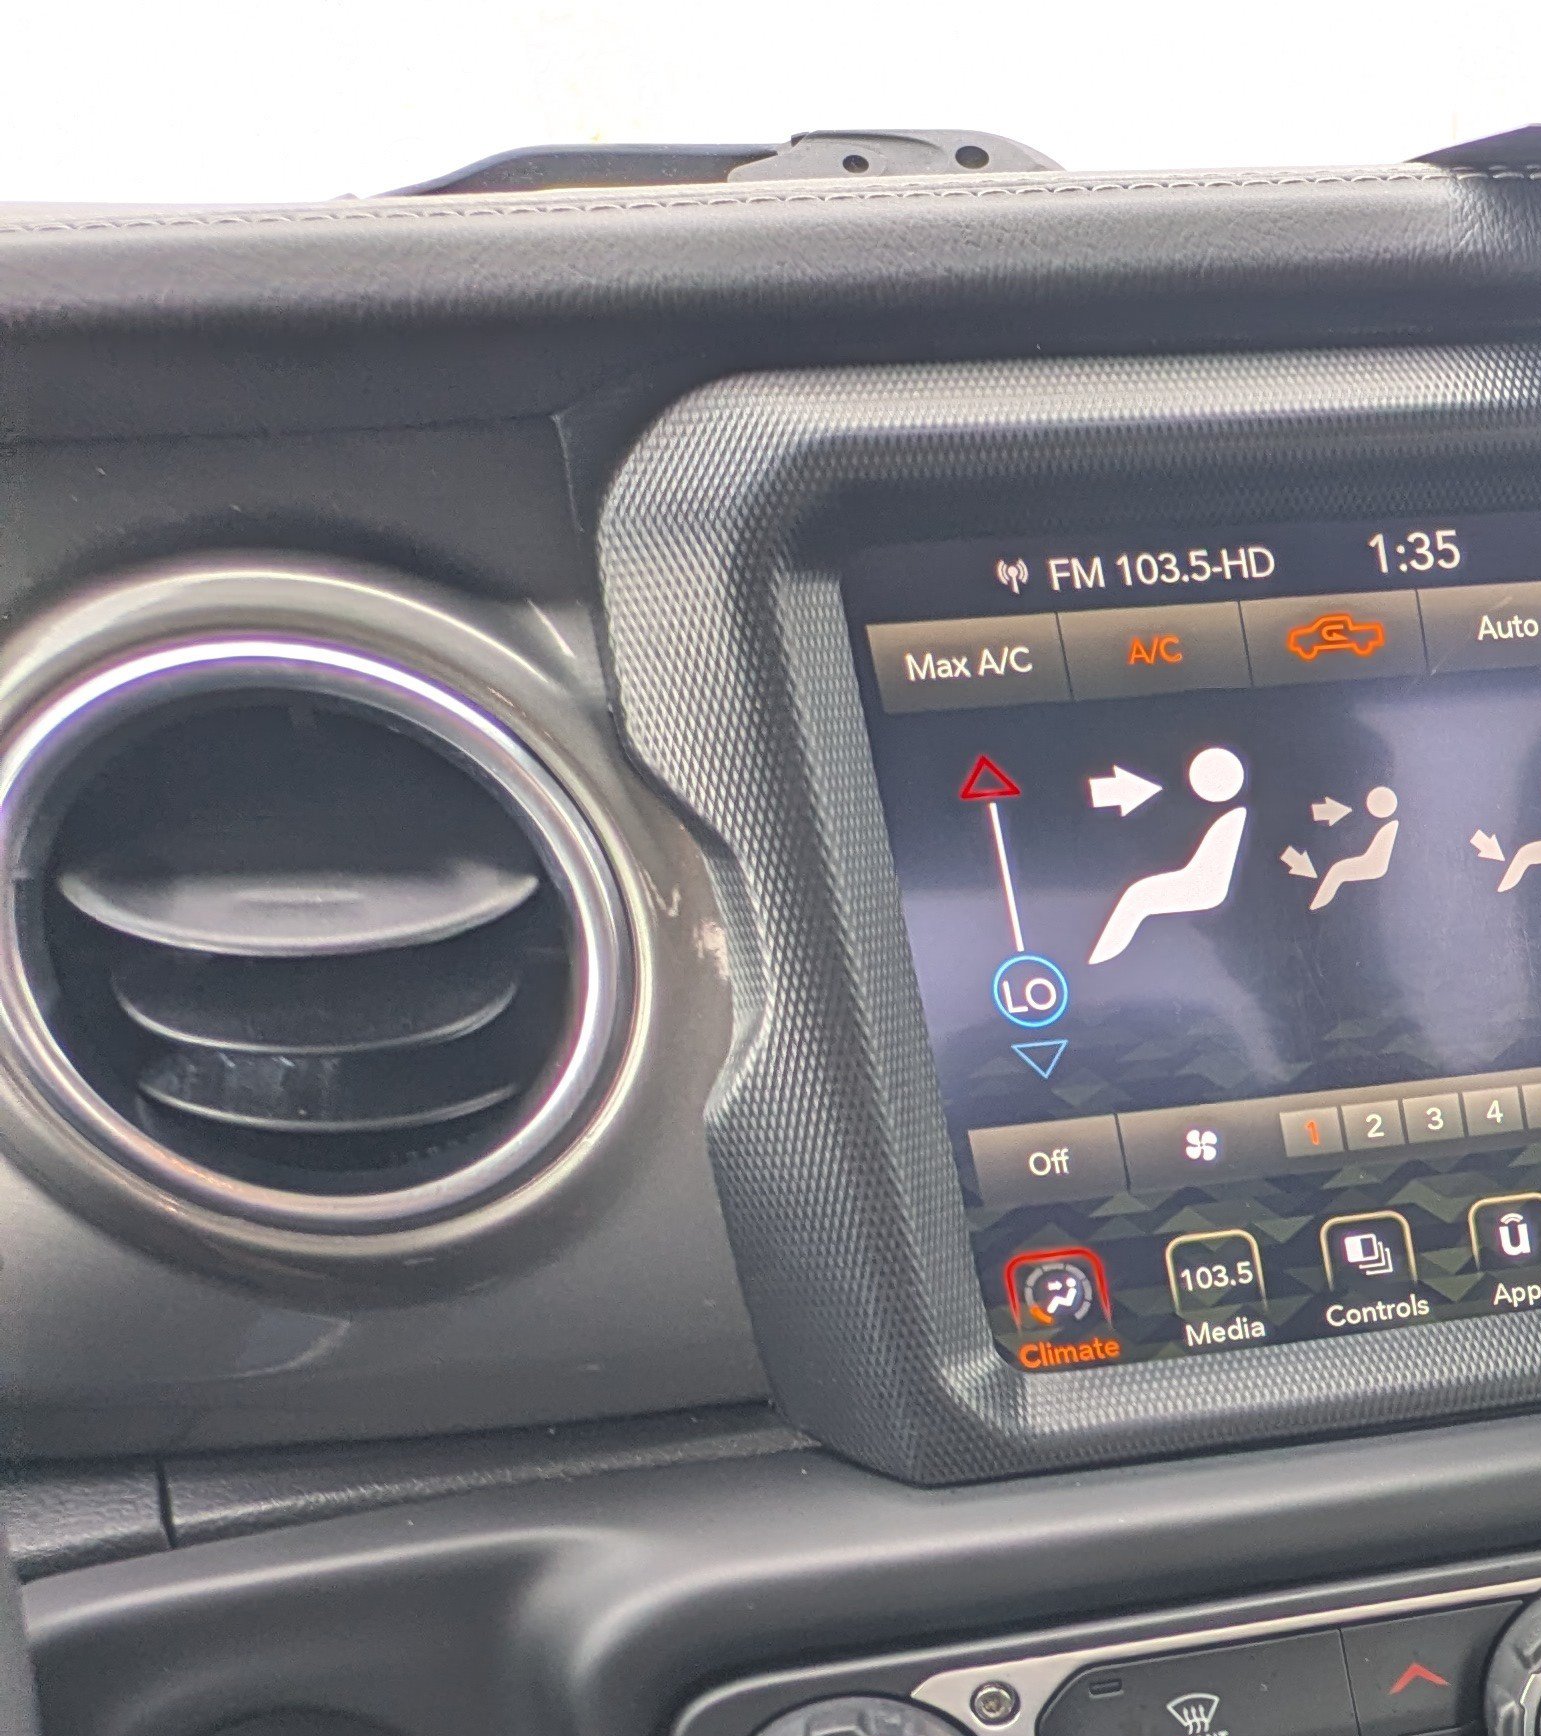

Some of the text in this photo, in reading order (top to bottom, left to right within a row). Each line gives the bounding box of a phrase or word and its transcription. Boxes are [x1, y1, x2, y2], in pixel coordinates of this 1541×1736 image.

[1367, 529, 1462, 574] 1:35
[1047, 546, 1276, 592] FM 103.5-HD
[1477, 613, 1540, 642] Auto
[905, 646, 1034, 682] Max A/C
[1128, 634, 1184, 665] A/C
[1002, 978, 1057, 1014] LO
[1365, 1114, 1385, 1138] 2
[1426, 1108, 1444, 1131] 3
[1485, 1100, 1504, 1124] 4
[1304, 1120, 1321, 1146] 1
[1028, 1148, 1070, 1176] Off
[1180, 1260, 1254, 1292] 103.5
[1325, 1293, 1430, 1327] Controls
[1184, 1318, 1266, 1348] Media
[1018, 1337, 1121, 1369] Climate
